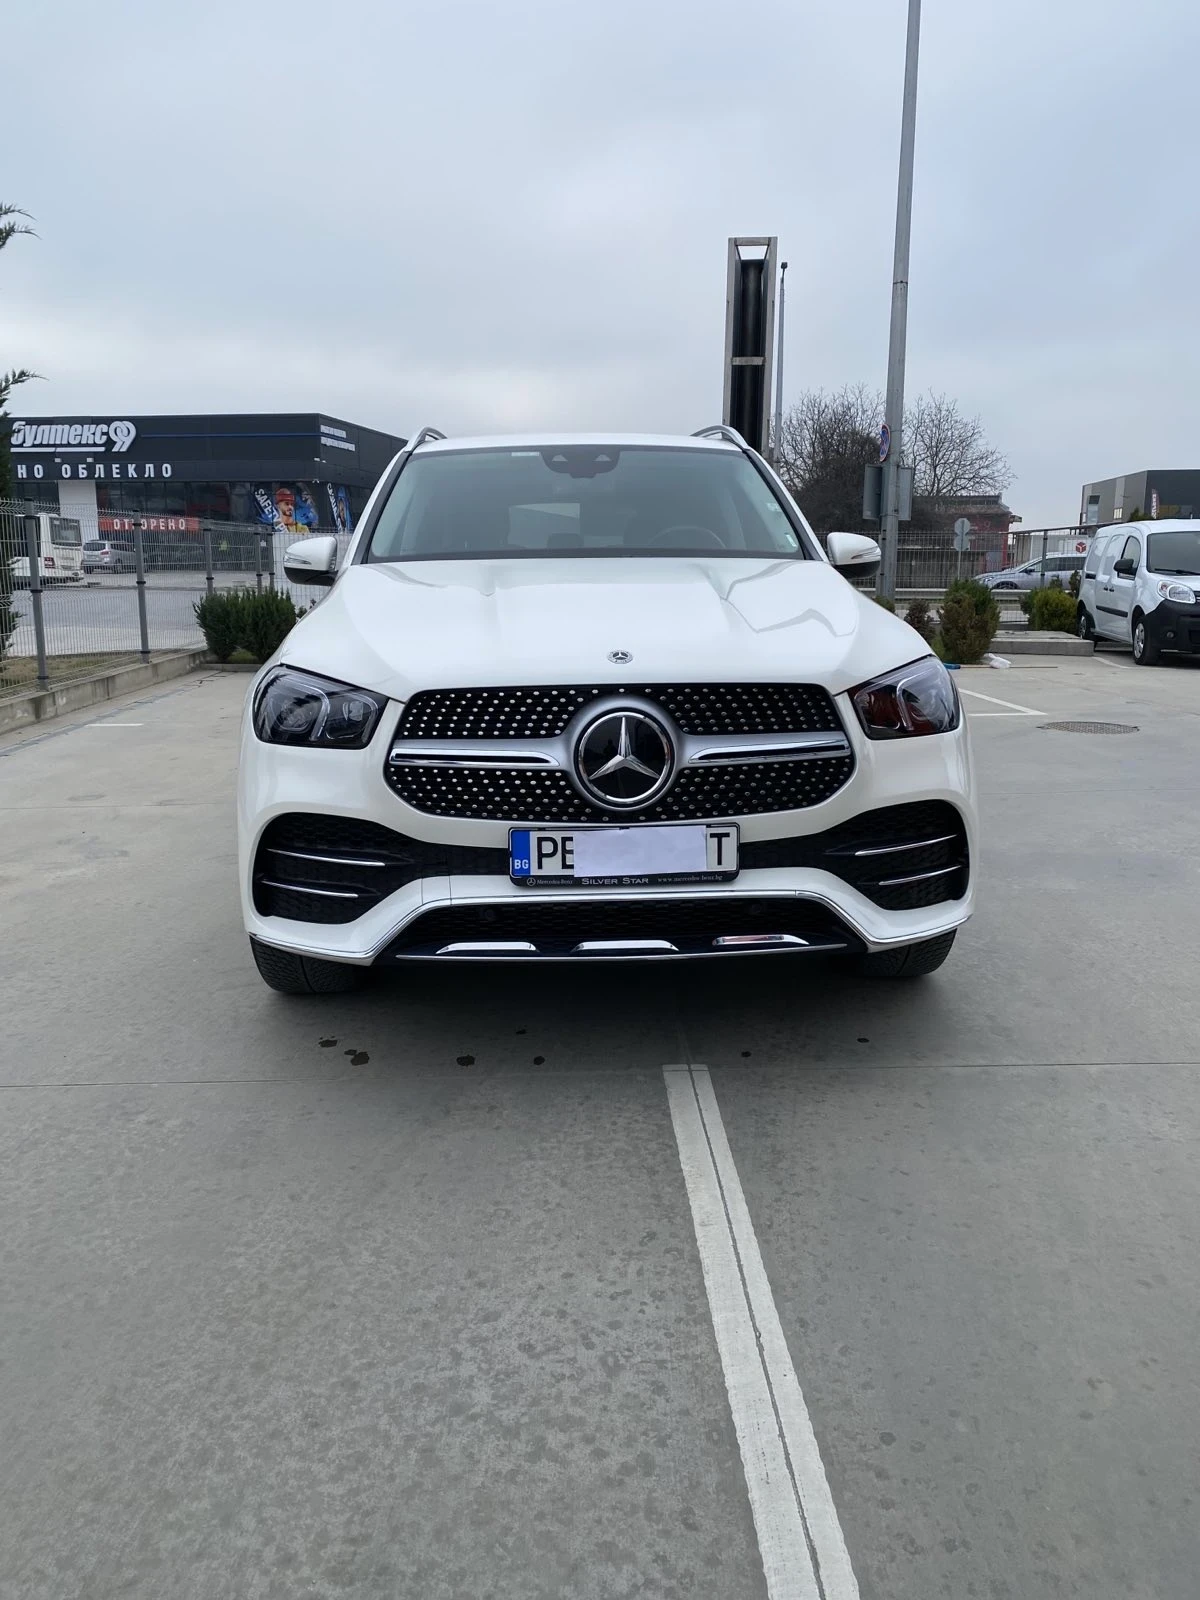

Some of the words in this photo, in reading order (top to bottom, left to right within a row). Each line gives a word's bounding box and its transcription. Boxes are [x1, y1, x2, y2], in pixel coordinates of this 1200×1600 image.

[61, 463, 173, 478] ОБЛЕКЛО
[113, 518, 186, 530] ОТОРЕНО
[514, 859, 529, 870] BG
[581, 877, 618, 885] SILVER
[622, 877, 649, 885] STAR
